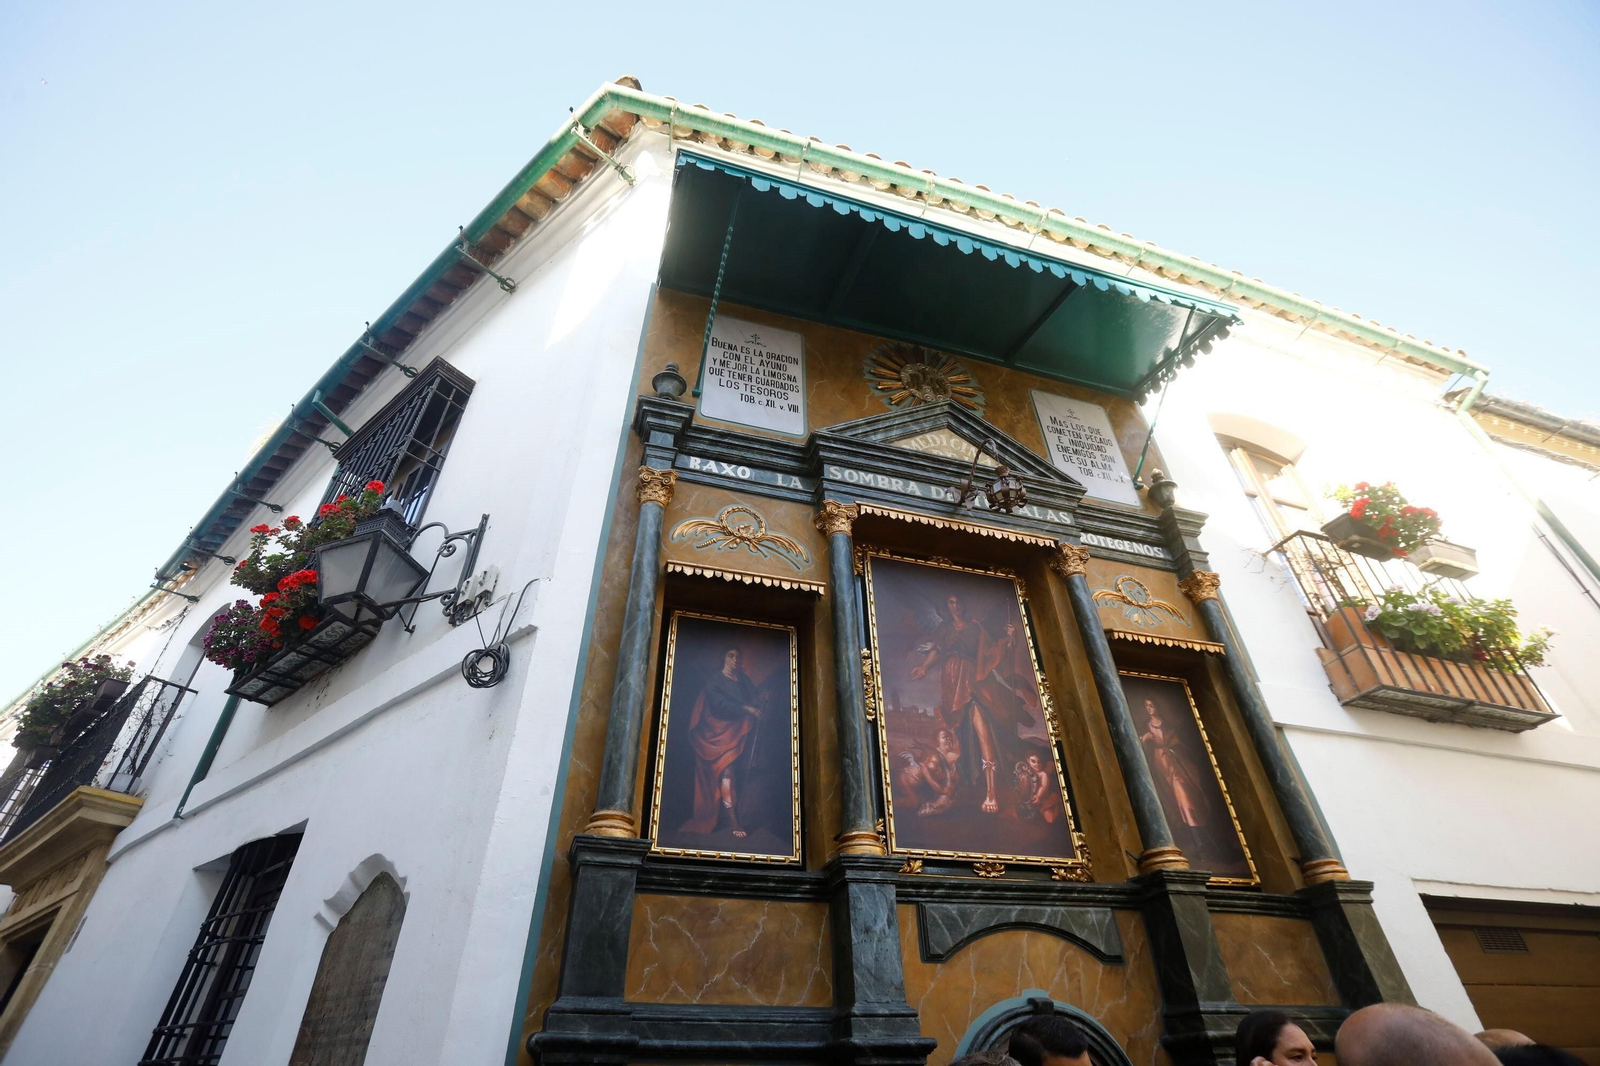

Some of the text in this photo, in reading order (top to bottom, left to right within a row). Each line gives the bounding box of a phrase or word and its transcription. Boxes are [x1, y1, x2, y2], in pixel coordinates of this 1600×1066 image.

[711, 337, 799, 366] BUENA ES LA ORACION
[723, 352, 788, 372] CON EL AYUNO
[709, 367, 800, 394] QUE TENER GUARDADOS
[712, 358, 718, 366] Y
[720, 359, 748, 372] MEJOR
[763, 370, 798, 384] LIMOSNA
[719, 379, 789, 401] LOS TESOROS
[1046, 425, 1114, 447] COMETEN PECADO
[1049, 416, 1103, 437] MAS LOS QUE
[1056, 444, 1116, 464] ENEMIGOS SON
[1057, 436, 1107, 454] E INIQUIDAD
[1062, 454, 1114, 472] DE SU ALMA
[777, 473, 803, 490] LA
[829, 466, 922, 497] SOMBRA
[1017, 505, 1072, 525] ALAS
[1080, 532, 1165, 558] ROTEGENOS
